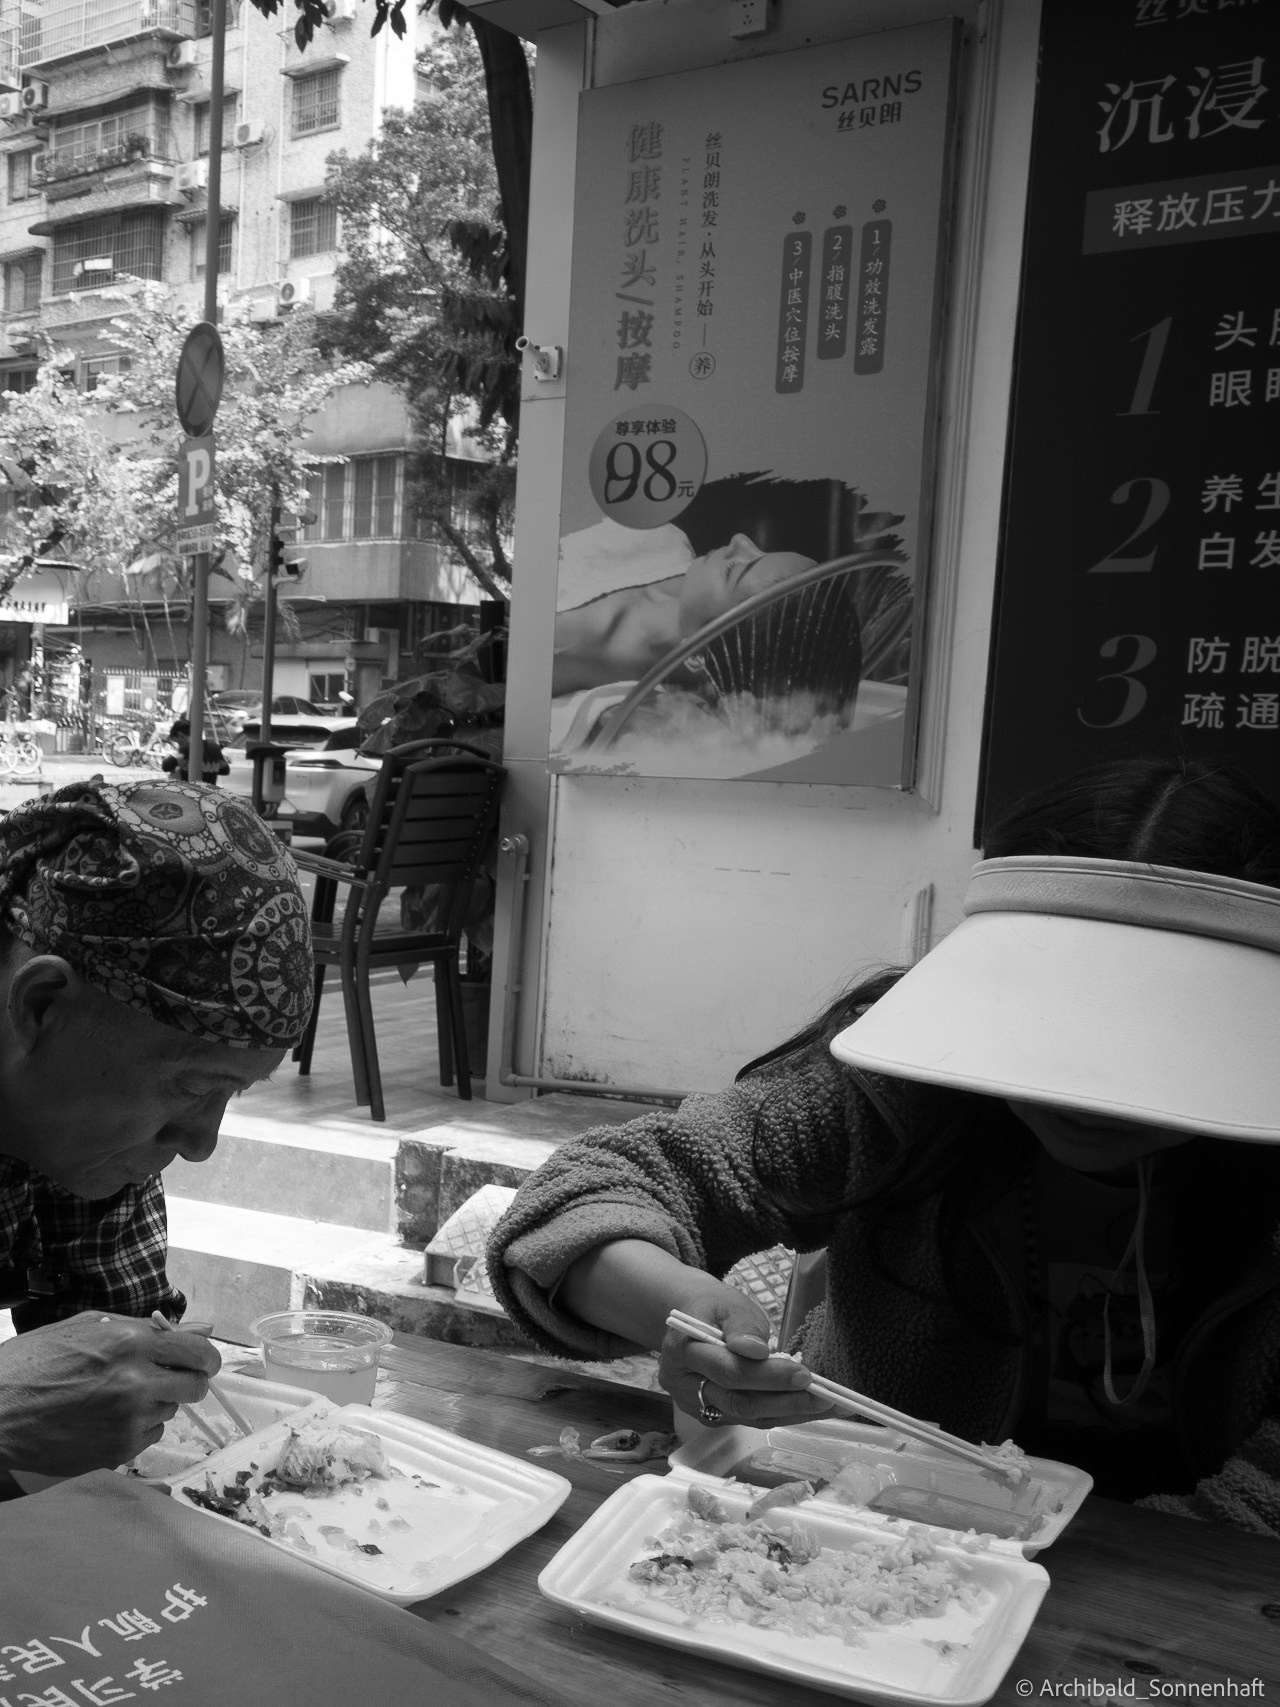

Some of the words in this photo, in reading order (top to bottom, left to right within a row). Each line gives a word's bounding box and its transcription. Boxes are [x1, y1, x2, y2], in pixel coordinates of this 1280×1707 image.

[821, 70, 923, 109] SARNS
[836, 101, 902, 132] 丝贝朗
[1116, 316, 1173, 416] 1
[615, 418, 677, 436] 尊享体验
[185, 448, 211, 517] P
[1087, 477, 1170, 573] 2
[1197, 529, 1280, 571] 白发
[1077, 634, 1157, 728] 3
[1181, 692, 1280, 729] 疏通
